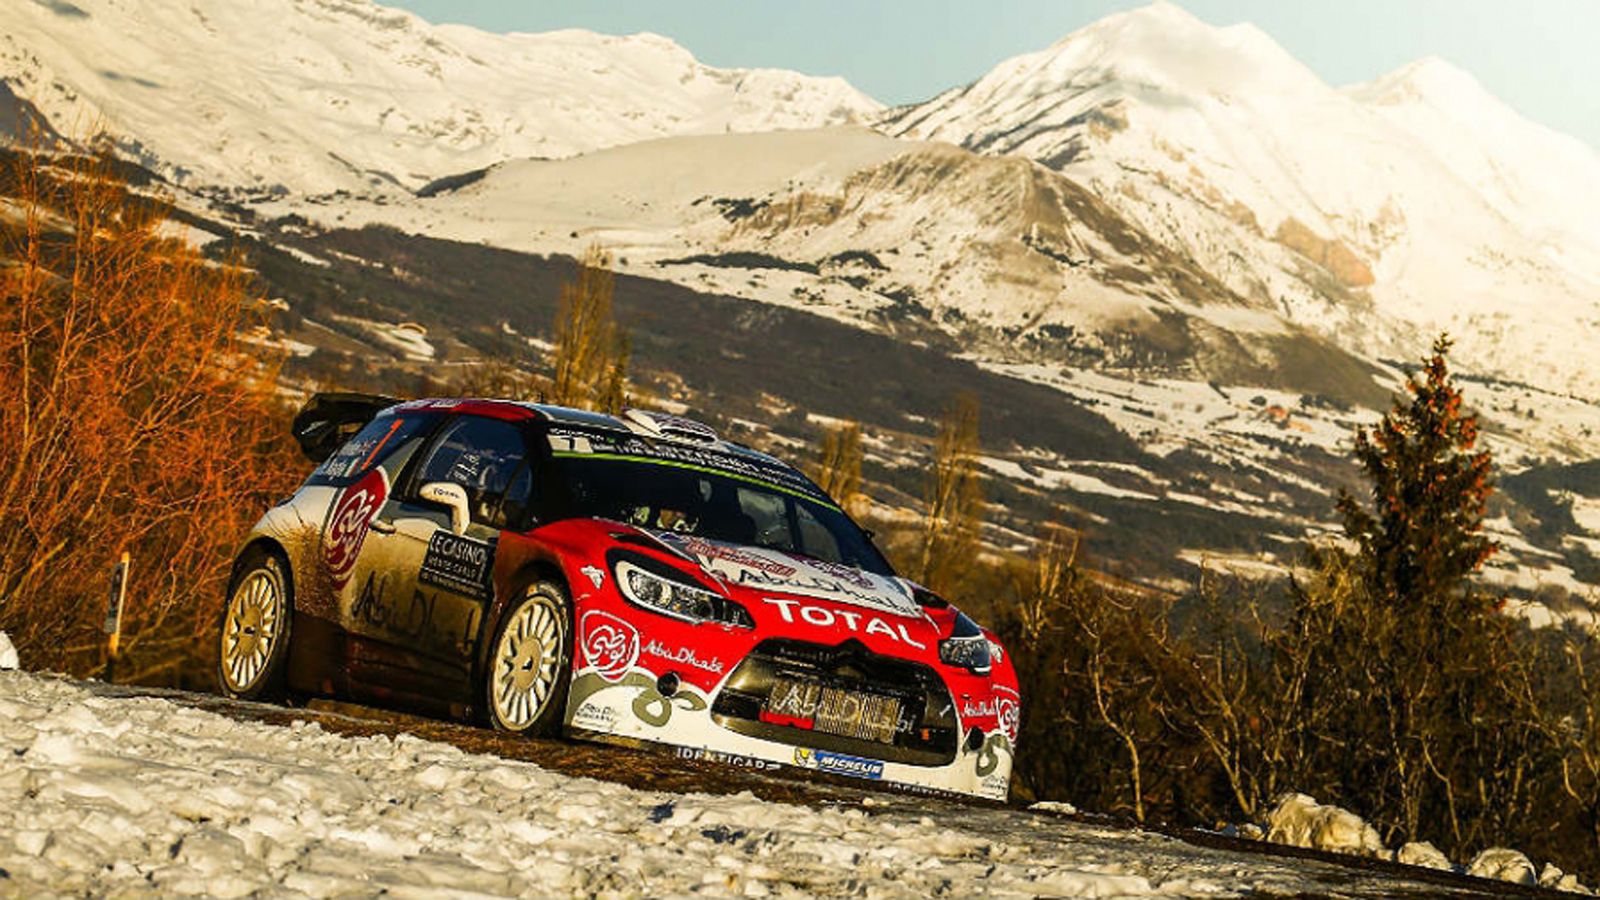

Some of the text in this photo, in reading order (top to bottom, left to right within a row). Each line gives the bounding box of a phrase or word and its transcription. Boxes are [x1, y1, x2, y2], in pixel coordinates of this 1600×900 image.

[442, 538, 487, 566] CASINO
[762, 597, 926, 650] TOTAL
[820, 756, 882, 774] MICHELIN
